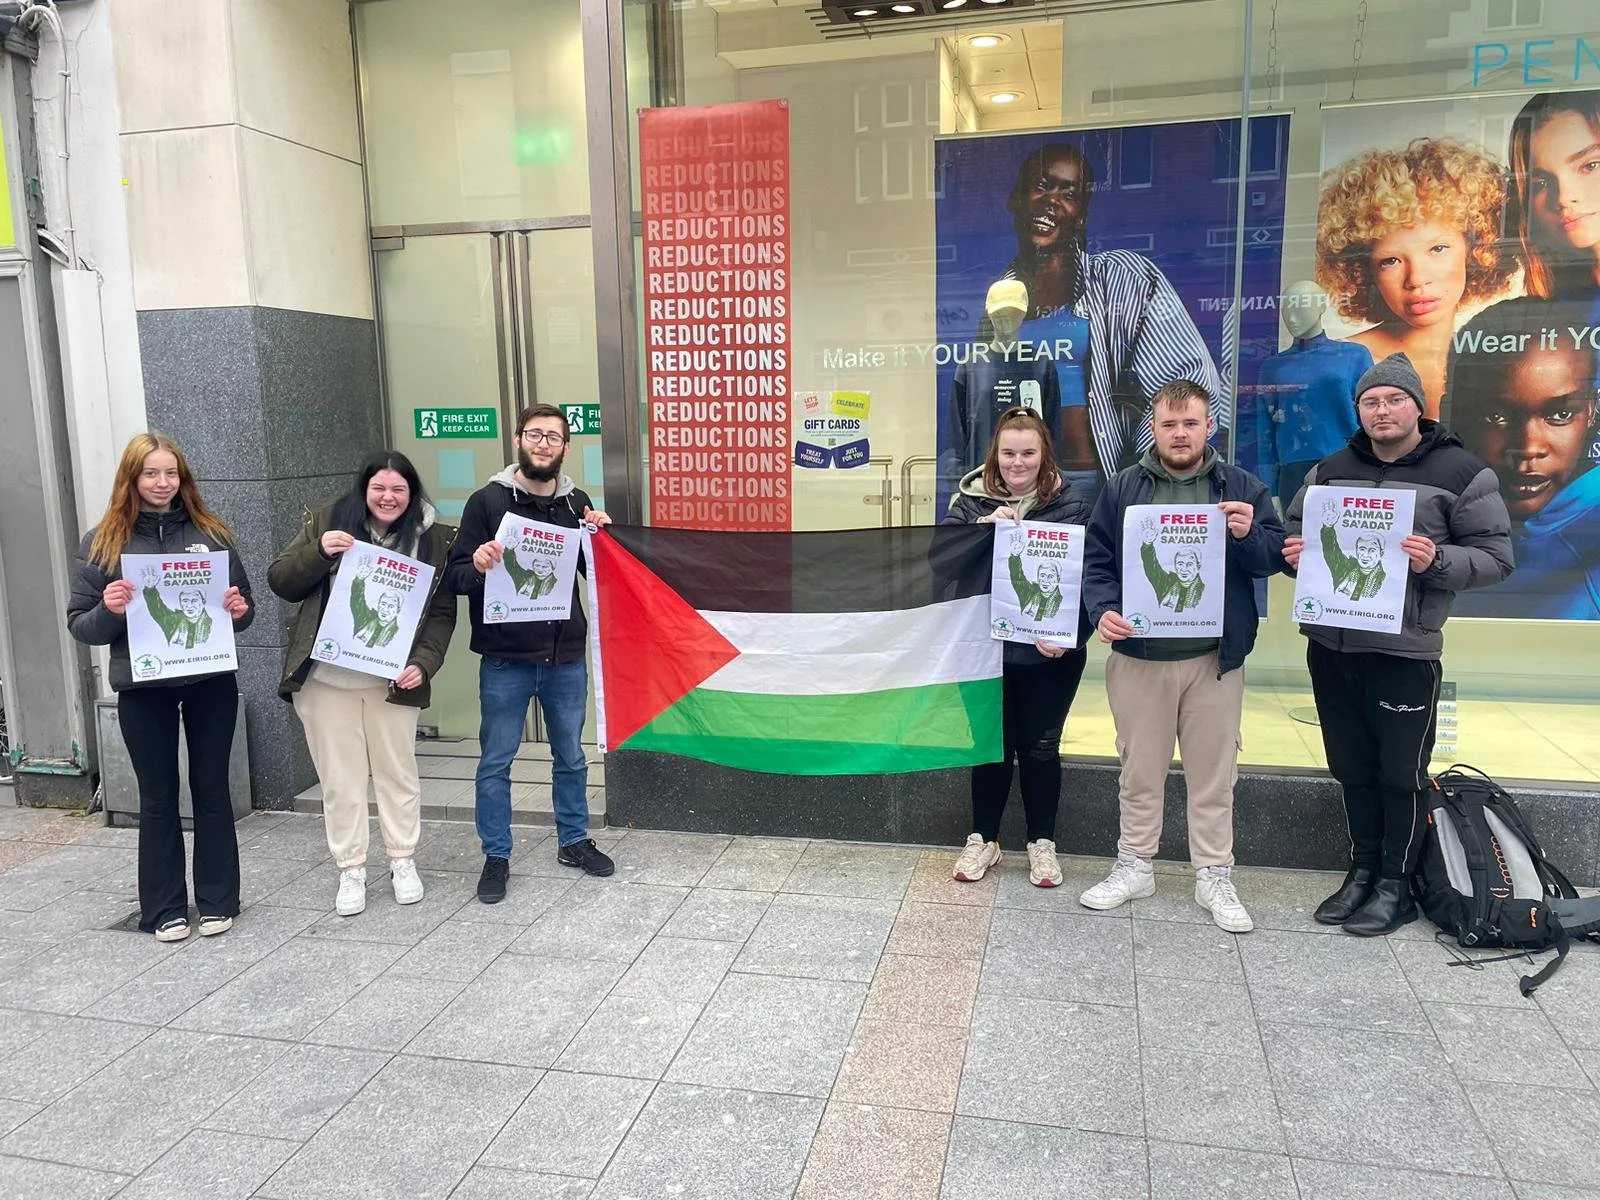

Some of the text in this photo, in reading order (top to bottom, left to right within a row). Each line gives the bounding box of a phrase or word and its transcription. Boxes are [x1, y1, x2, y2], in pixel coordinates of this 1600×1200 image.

[645, 160, 785, 187] REDUCTIONS
[646, 187, 785, 214] REDUCTIONS
[647, 214, 786, 241] REDUCTIONS
[648, 242, 786, 267] REDUCTIONS
[649, 269, 786, 294] REDUCTIONS
[650, 295, 786, 320] REDUCTIONS
[650, 322, 787, 346] REDUCTIONS
[1452, 330, 1531, 354] Wear
[1540, 327, 1558, 351] it
[651, 349, 787, 372] REDUCTIONS
[823, 339, 1073, 369] Make it YOUR YEAR
[652, 375, 787, 397] REDUCTIONS
[836, 399, 865, 409] CELEBRATE
[653, 401, 787, 422] REDUCTIONS
[442, 414, 489, 423] FIRE EXIT
[588, 421, 601, 429] KE
[804, 419, 860, 430] GIFT CARDS
[442, 424, 490, 433] KEEP CLEAR
[653, 427, 787, 448] REDUCTIONS
[800, 453, 824, 464] YOURSELF
[806, 449, 822, 458] TREAT
[842, 454, 853, 463] FOR
[853, 452, 864, 460] YOU
[654, 452, 787, 473] REDUCTIONS
[655, 476, 787, 498] REDUCTIONS
[1343, 497, 1395, 510] FREE
[655, 501, 787, 523] REDUCTIONS
[1343, 510, 1394, 520] AHMAD
[1160, 514, 1208, 524] FREE
[1342, 520, 1393, 531] SA'ADAT
[523, 527, 565, 543] FREE
[1027, 529, 1069, 542] FREE
[1161, 526, 1208, 534] AHMAD
[522, 537, 564, 550] AHMAD
[1028, 540, 1068, 550] AHMAD
[1160, 536, 1208, 544] SA'ADAT
[521, 545, 564, 557] SA'ADAT
[1027, 549, 1068, 559] SA'ADAT
[162, 560, 211, 571] FREE
[377, 556, 419, 577] FREE
[163, 570, 211, 579] AHMAD
[374, 567, 416, 584] AHMAD
[163, 578, 211, 586] SA'ADAT
[371, 575, 414, 593] SA'ADAT
